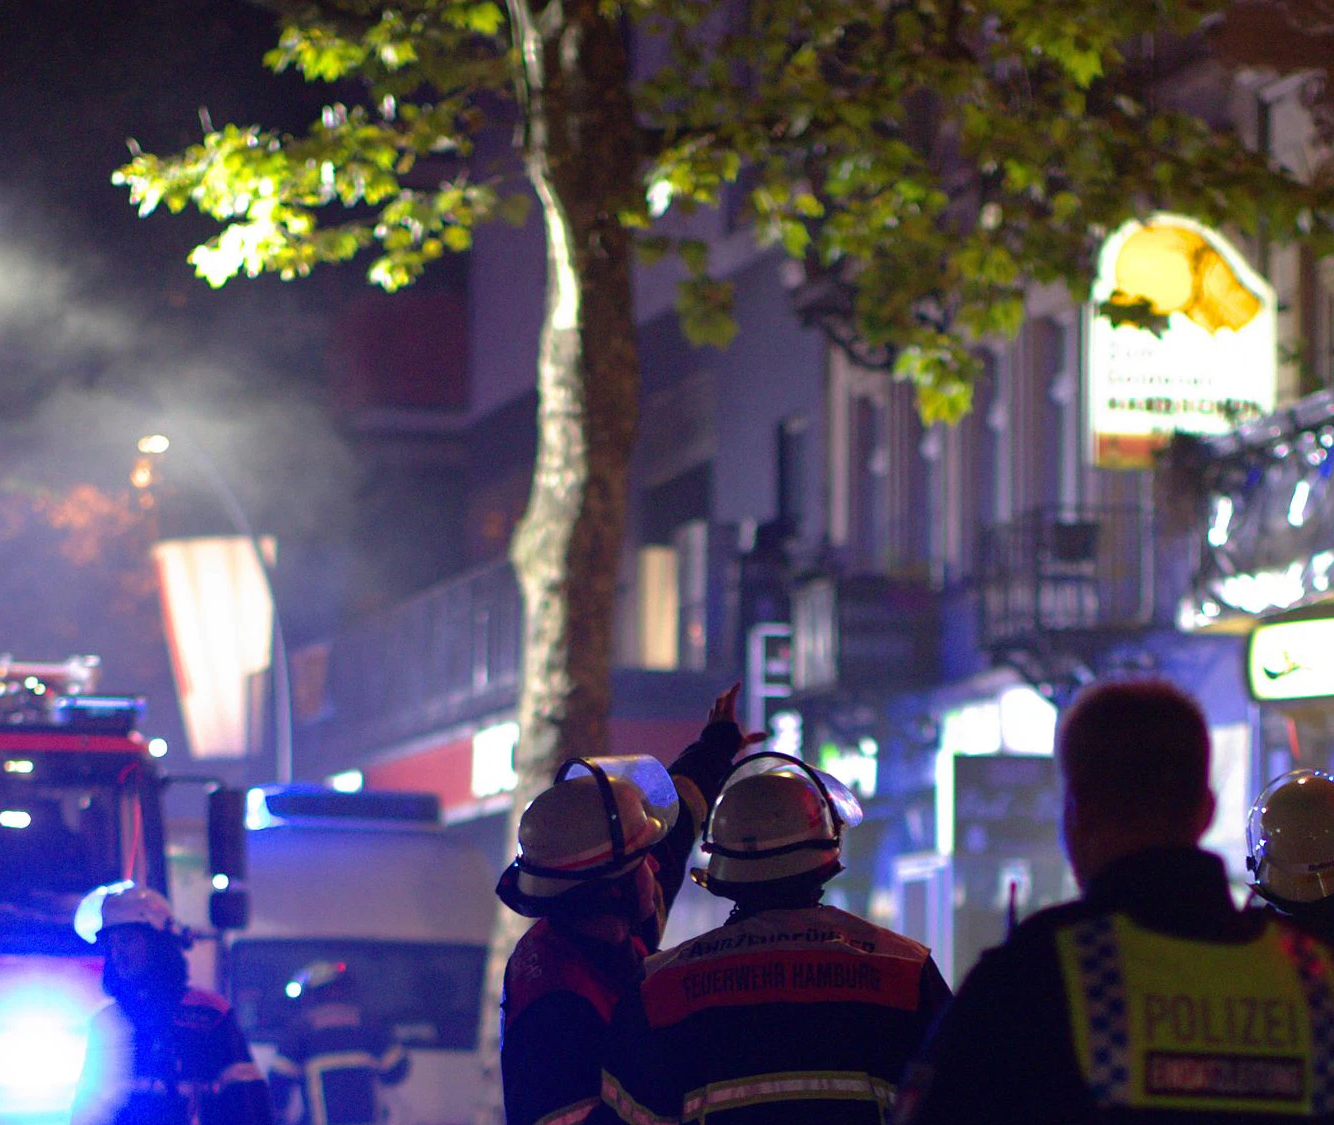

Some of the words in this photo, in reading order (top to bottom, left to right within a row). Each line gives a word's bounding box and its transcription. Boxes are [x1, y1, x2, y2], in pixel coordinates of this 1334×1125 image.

[682, 962, 786, 1000] FEUERWEHR
[792, 962, 882, 992] HAMBURG
[1145, 993, 1296, 1047] POLIZEI
